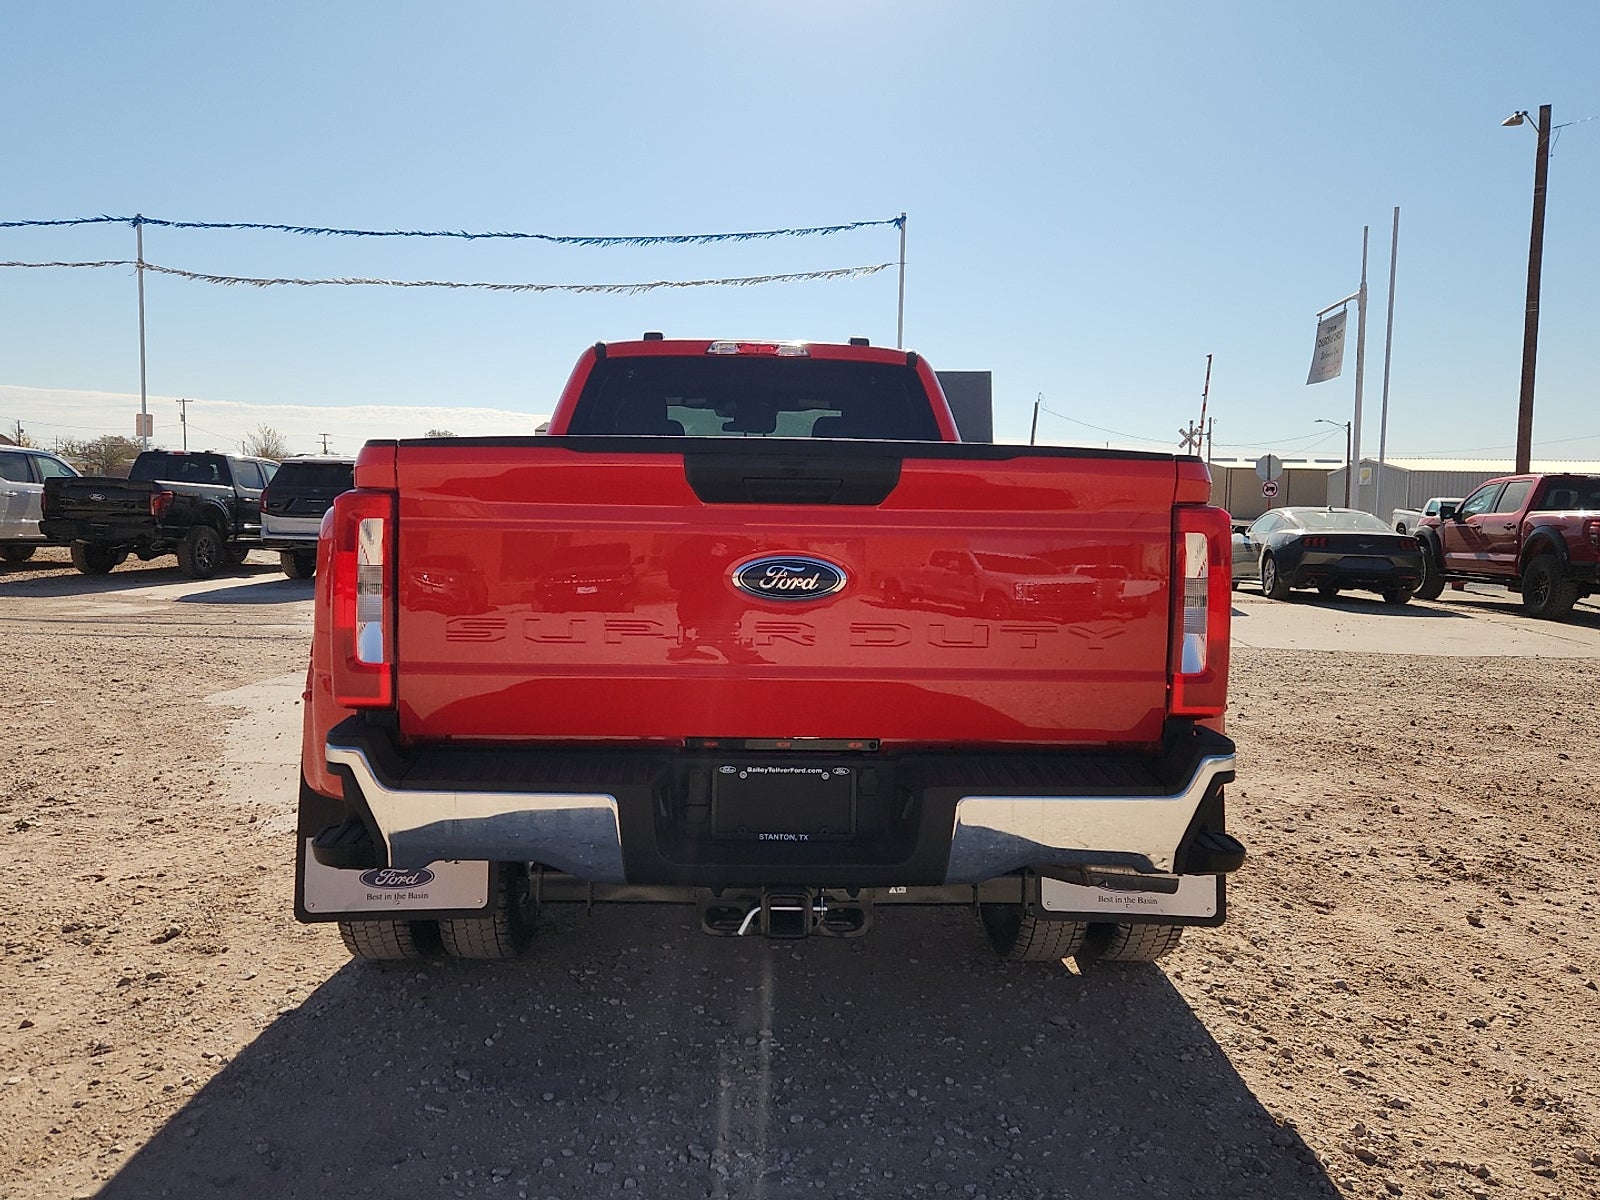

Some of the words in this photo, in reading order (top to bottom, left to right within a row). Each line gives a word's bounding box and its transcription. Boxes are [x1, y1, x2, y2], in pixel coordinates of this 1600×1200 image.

[758, 565, 820, 590] Ford
[446, 617, 817, 647] SUPR
[848, 621, 1127, 650] DUTY
[759, 833, 797, 842] STANTON,
[375, 868, 419, 885] Ford
[394, 892, 405, 900] the
[1098, 895, 1114, 904] Best
[1115, 896, 1122, 904] in
[1124, 896, 1135, 904] the
